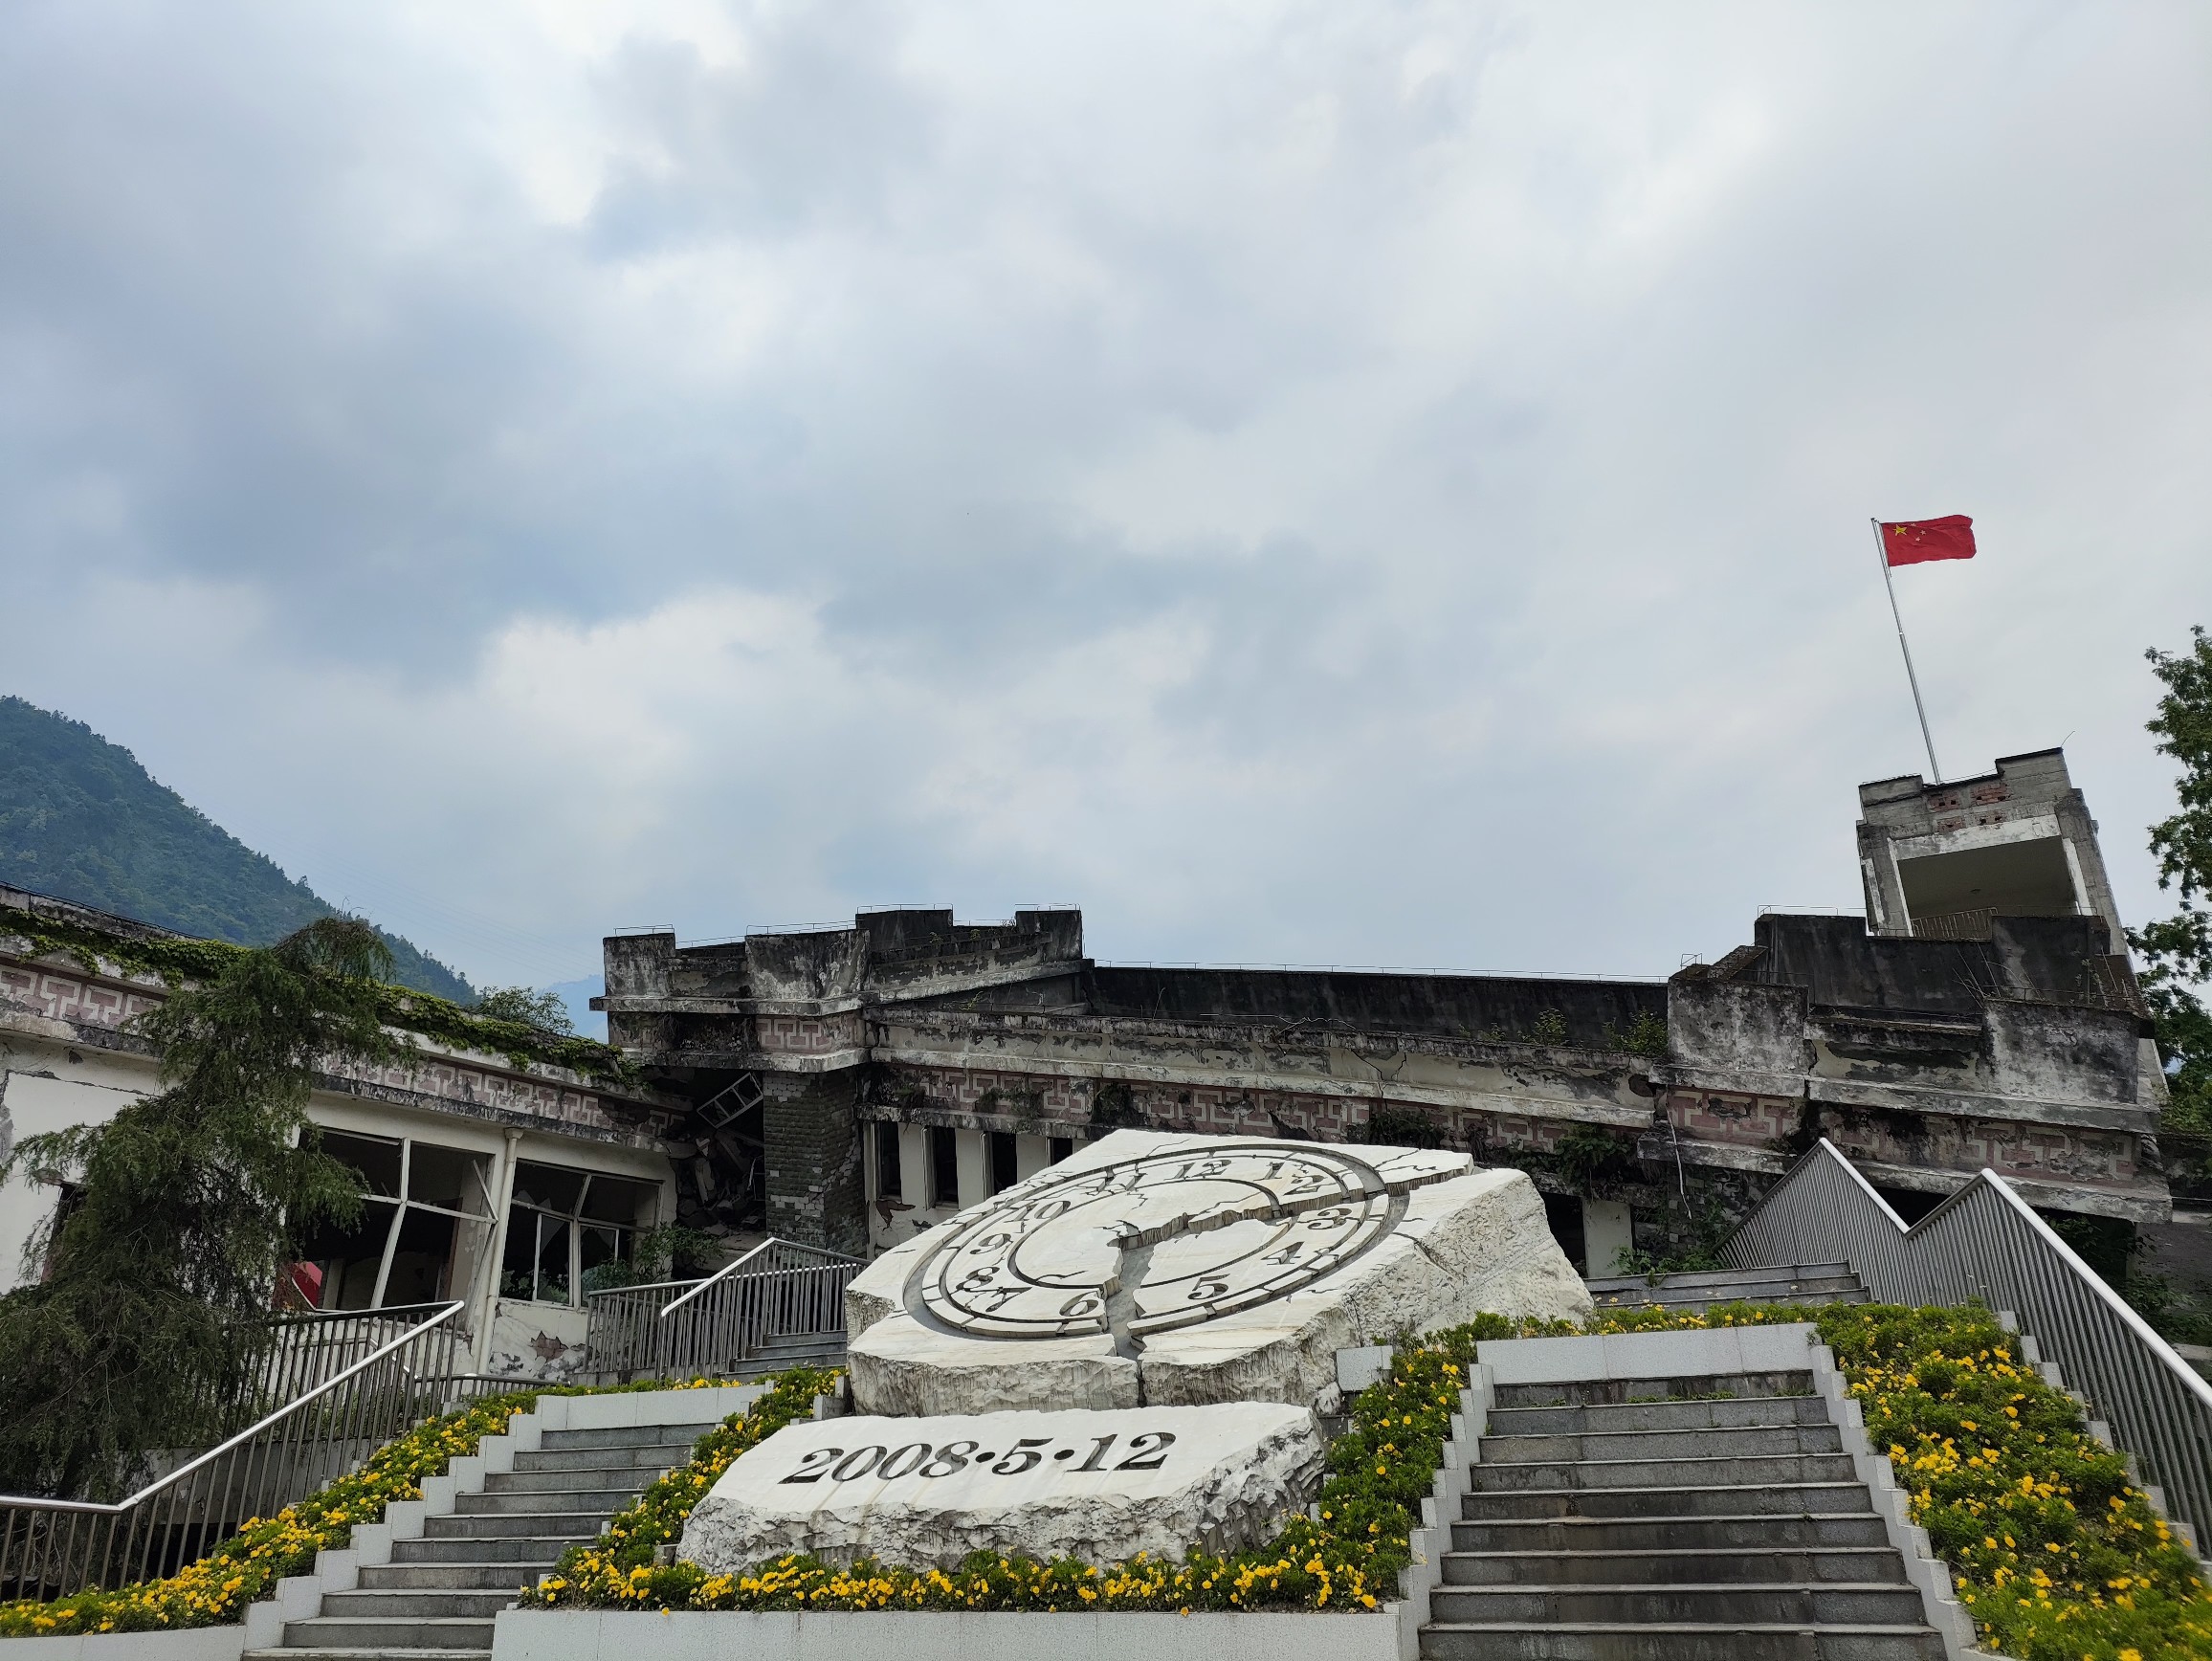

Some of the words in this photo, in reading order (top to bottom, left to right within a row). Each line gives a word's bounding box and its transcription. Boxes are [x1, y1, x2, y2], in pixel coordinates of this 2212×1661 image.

[1164, 1159, 1232, 1181] 12
[1253, 1161, 1285, 1182] 1
[1282, 1174, 1328, 1196] 2
[1004, 1200, 1072, 1223] 10
[1307, 1207, 1353, 1230] 3
[969, 1232, 1012, 1255] 9
[1261, 1241, 1305, 1266] 4
[956, 1266, 1001, 1293] 8
[1187, 1273, 1231, 1300] 5
[985, 1286, 1033, 1313] 7
[1058, 1291, 1099, 1317] 6
